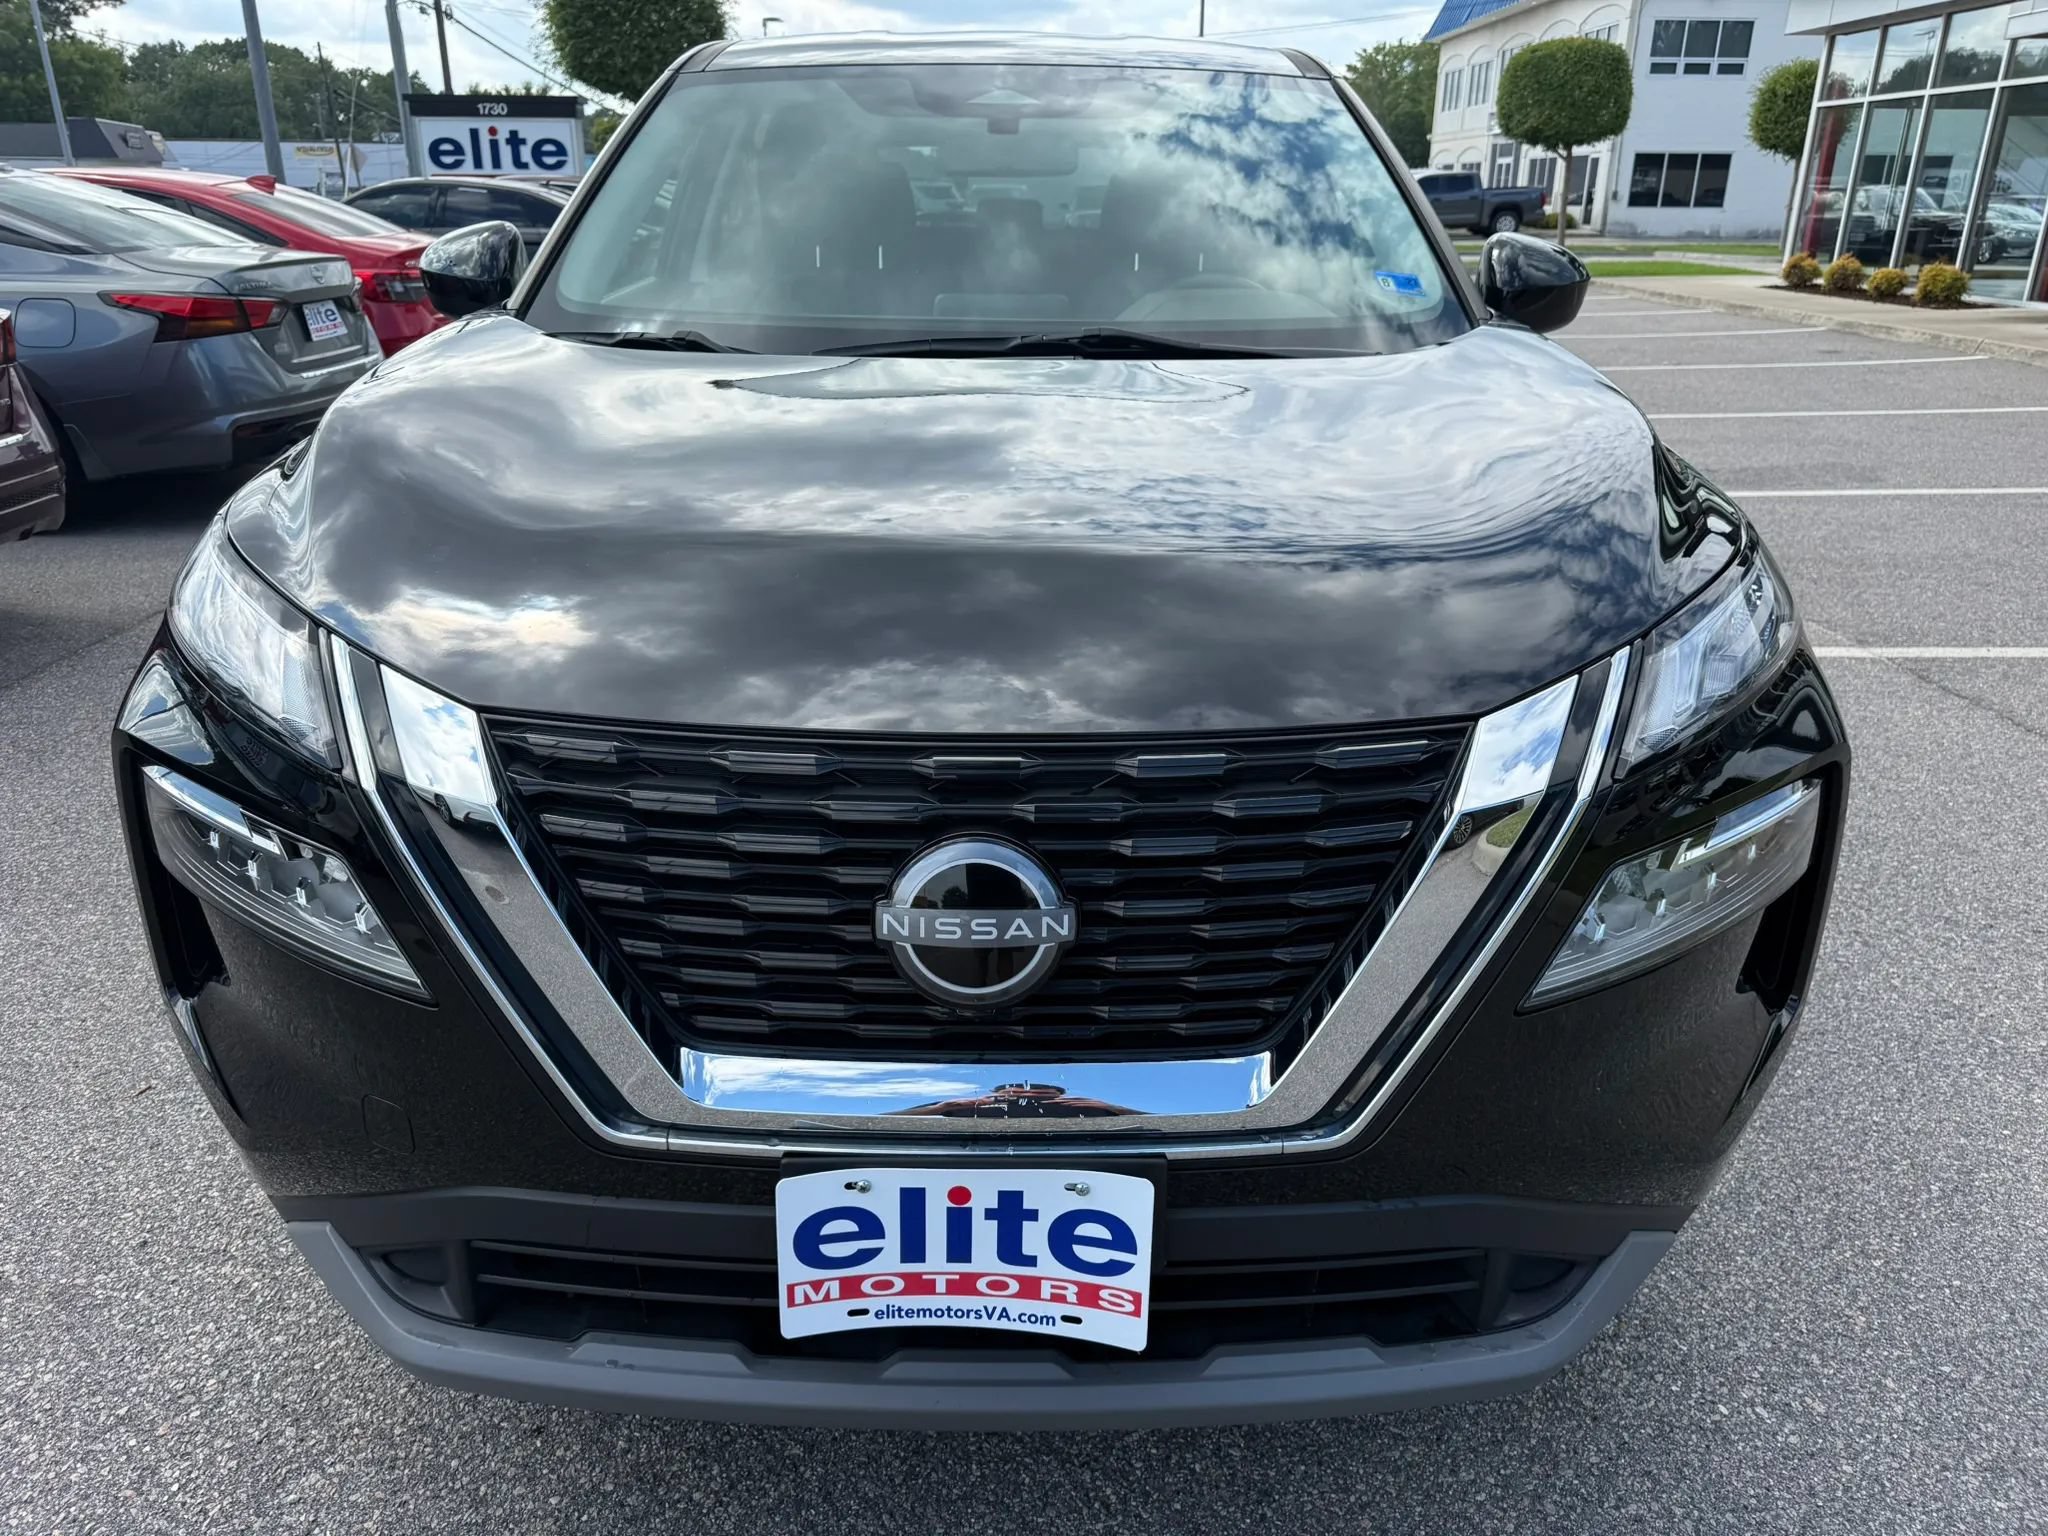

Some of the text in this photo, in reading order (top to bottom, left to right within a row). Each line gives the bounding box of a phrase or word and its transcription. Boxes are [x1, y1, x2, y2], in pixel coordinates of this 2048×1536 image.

[477, 103, 508, 115] 1730
[428, 126, 568, 171] elite
[882, 913, 1069, 940] NISSAN
[793, 1185, 1138, 1277] elite
[793, 1274, 1136, 1313] MOTORS
[874, 1304, 1056, 1327] elitemotorsVA.com
